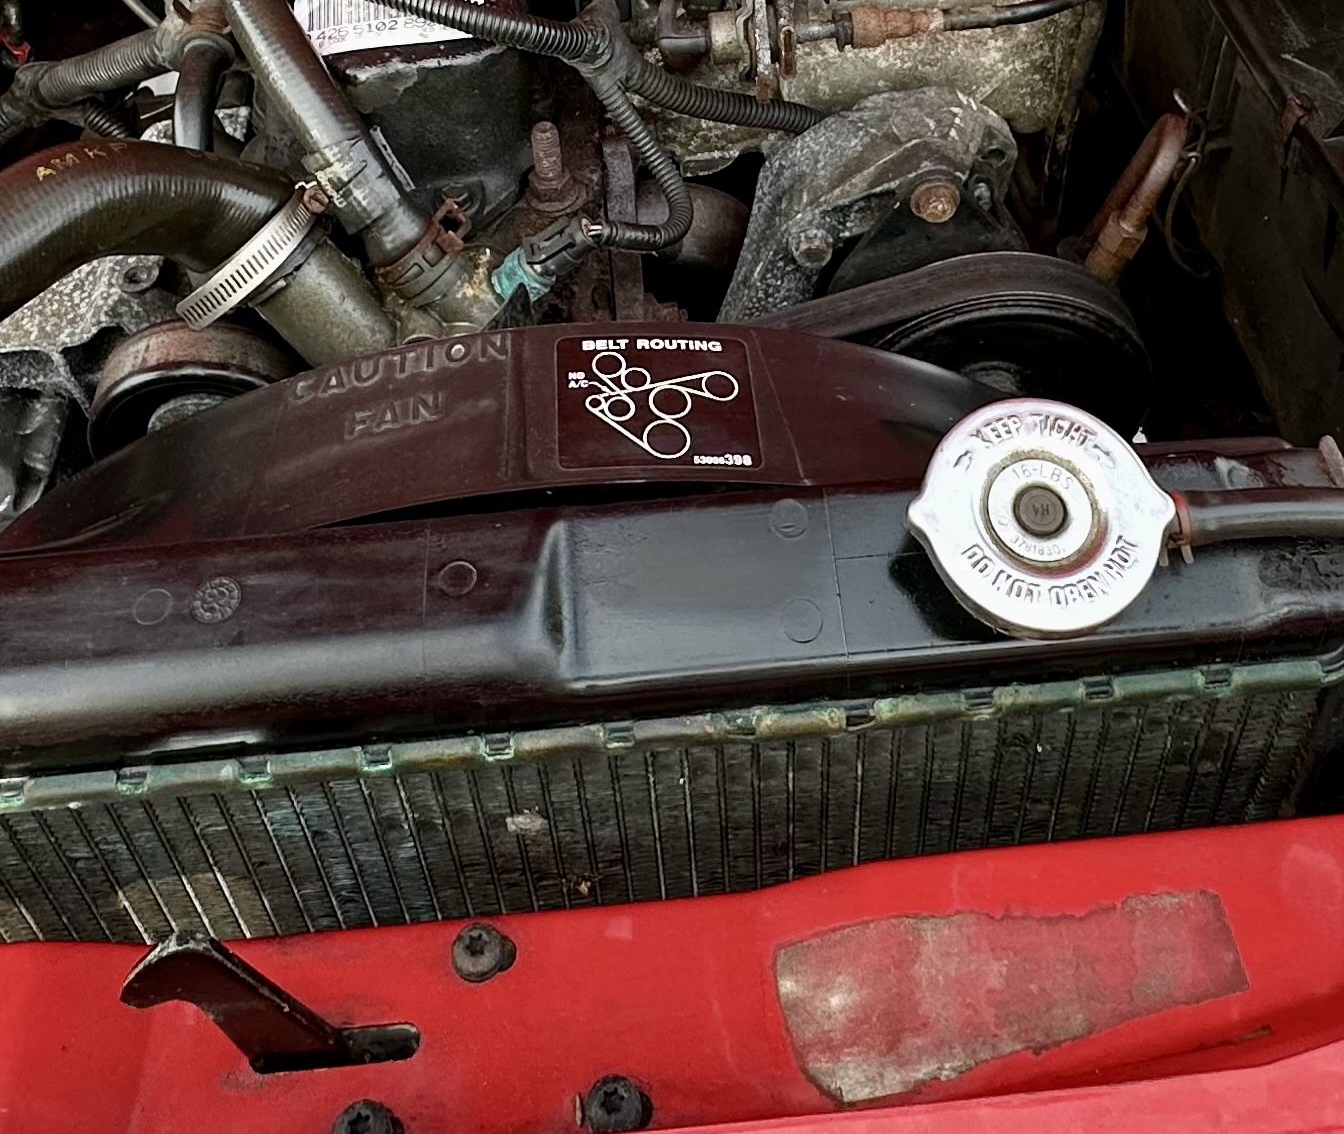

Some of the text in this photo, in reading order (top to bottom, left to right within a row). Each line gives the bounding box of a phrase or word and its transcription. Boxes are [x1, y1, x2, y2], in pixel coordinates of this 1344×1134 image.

[353, 19, 398, 36] 5102
[582, 338, 723, 352] BELT ROUTING
[287, 332, 510, 405] CAUTION
[568, 380, 589, 388] A/C
[344, 392, 446, 440] FAN
[970, 413, 1098, 449] KEEP TIGHT
[1012, 463, 1074, 490] 16-LBS
[960, 534, 1140, 607] DO NOT OPEN HOT
